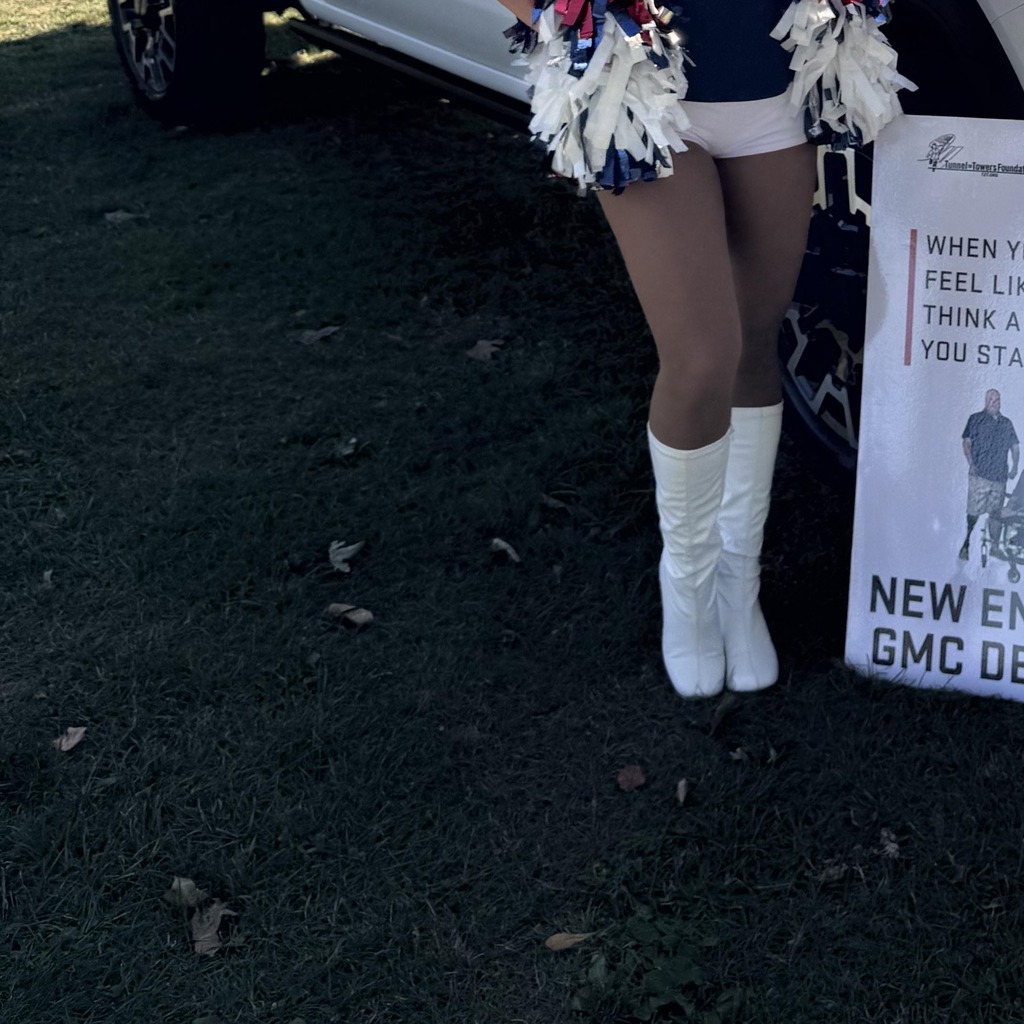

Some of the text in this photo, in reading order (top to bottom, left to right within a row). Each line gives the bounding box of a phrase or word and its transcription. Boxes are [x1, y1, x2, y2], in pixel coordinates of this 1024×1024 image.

[926, 235, 997, 259] WHEN
[925, 270, 983, 293] FEEL
[923, 305, 996, 330] THINK
[921, 339, 967, 362] YOU
[869, 575, 967, 623] NEW
[872, 627, 964, 675] GMC
